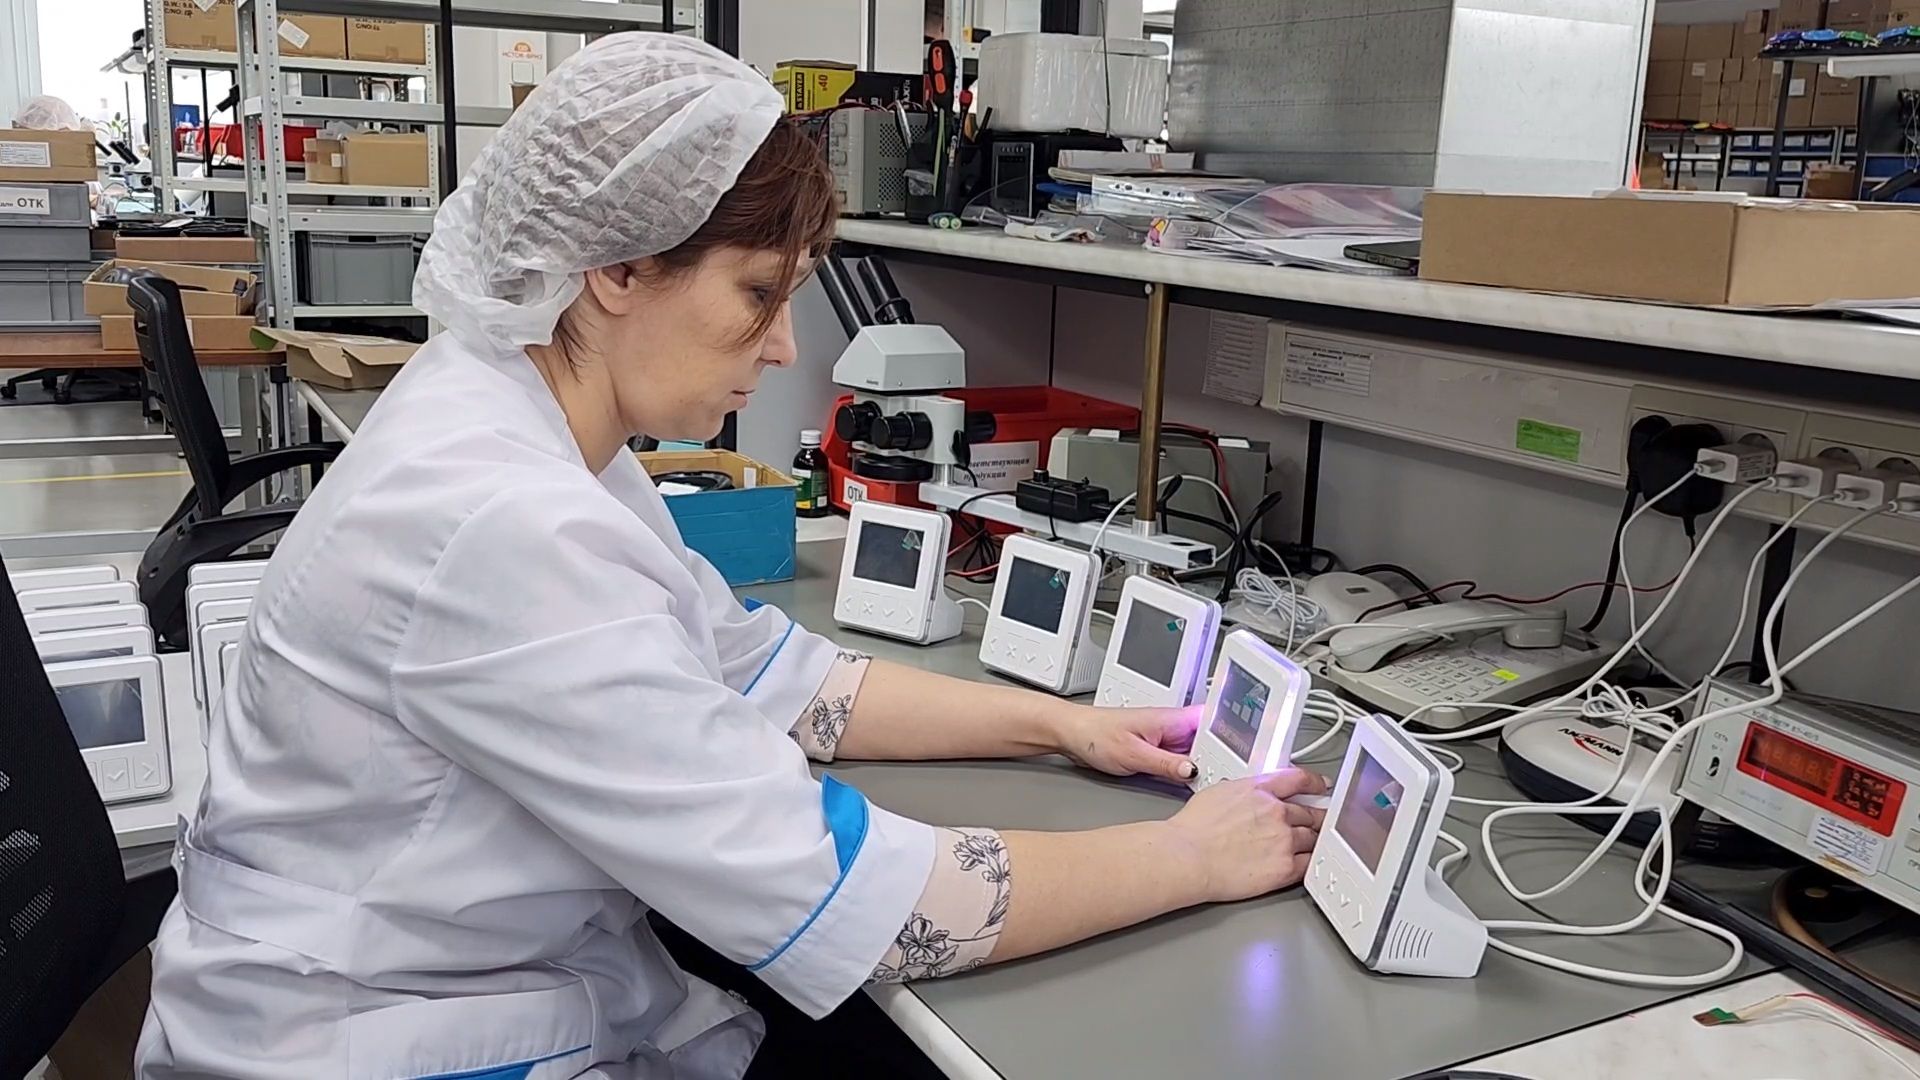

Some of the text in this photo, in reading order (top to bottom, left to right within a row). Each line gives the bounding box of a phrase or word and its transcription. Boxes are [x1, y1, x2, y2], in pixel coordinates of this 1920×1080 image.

[796, 73, 804, 101] STAYER
[17, 197, 44, 208] ОТК
[969, 459, 1029, 469] ветствующая
[963, 471, 1006, 481] прдукция
[847, 485, 864, 501] ОТК
